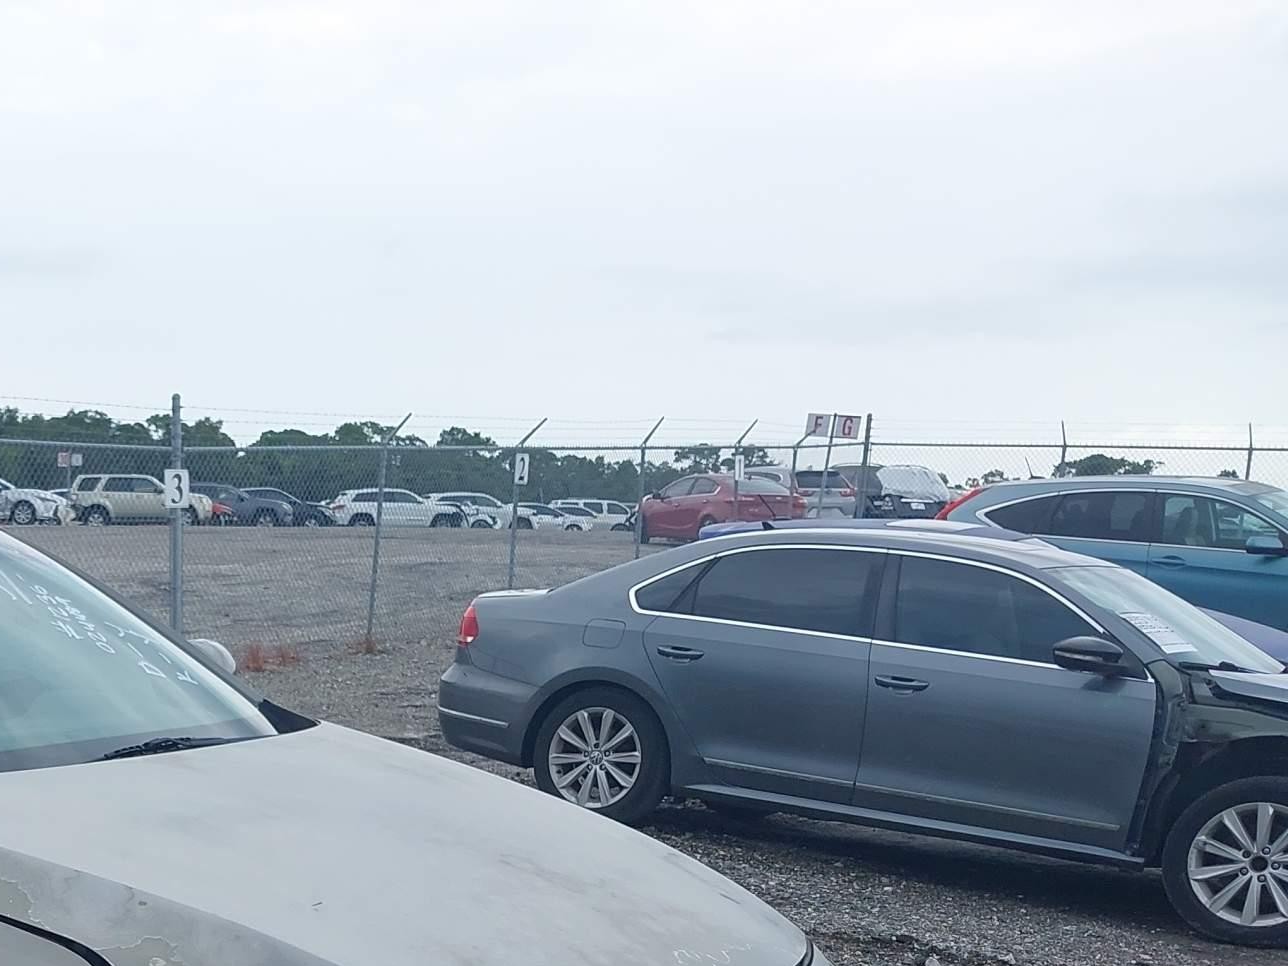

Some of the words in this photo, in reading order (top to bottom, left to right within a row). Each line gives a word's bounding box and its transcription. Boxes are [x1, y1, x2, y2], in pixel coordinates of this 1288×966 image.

[813, 416, 824, 434] F
[841, 417, 854, 436] G
[518, 456, 526, 481] 2
[171, 473, 183, 504] 3
